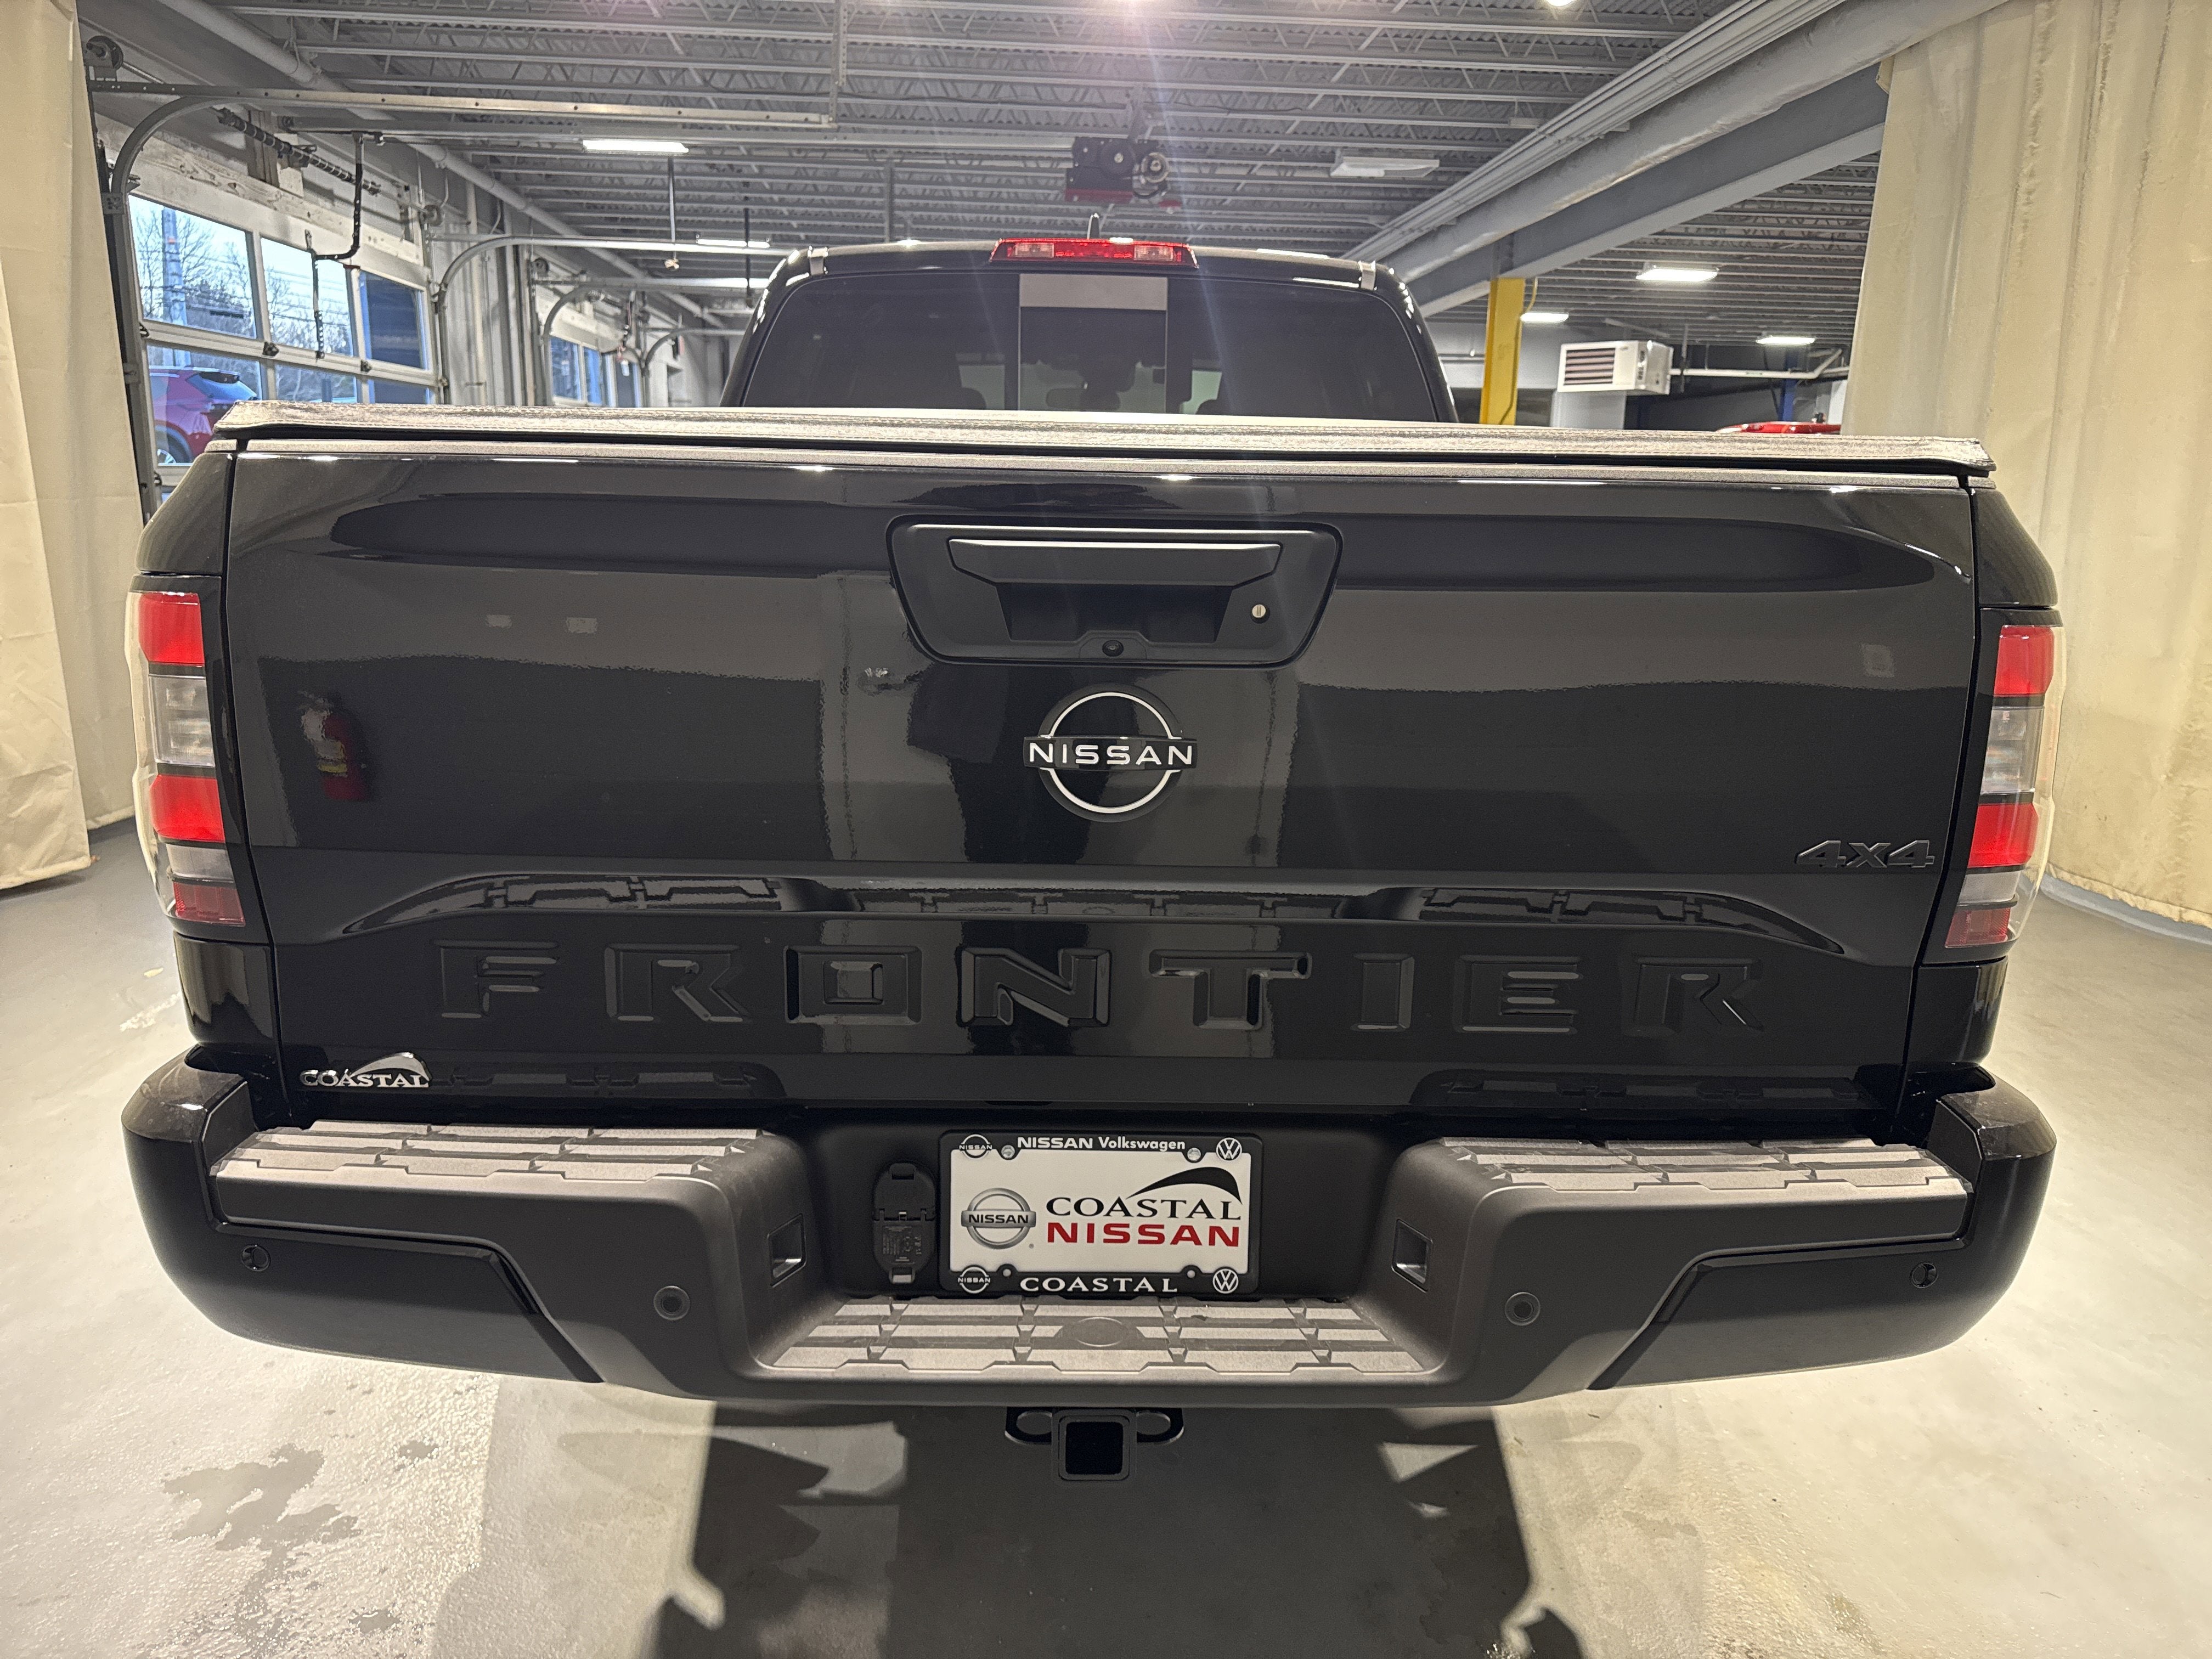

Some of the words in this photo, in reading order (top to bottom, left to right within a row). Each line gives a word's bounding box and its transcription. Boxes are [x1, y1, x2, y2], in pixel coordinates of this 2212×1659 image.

[1029, 742, 1192, 765] NISSAN
[432, 939, 1763, 1034] FRONTIER
[300, 1069, 430, 1088] COASTAL
[1018, 1137, 1093, 1148] NISSAN
[1098, 1136, 1186, 1152] Volkswagen
[969, 1214, 1029, 1223] NISSAN
[1046, 1196, 1242, 1220] COASTAL
[1047, 1222, 1239, 1247] NISSAN
[1020, 1276, 1178, 1293] COASTAL
